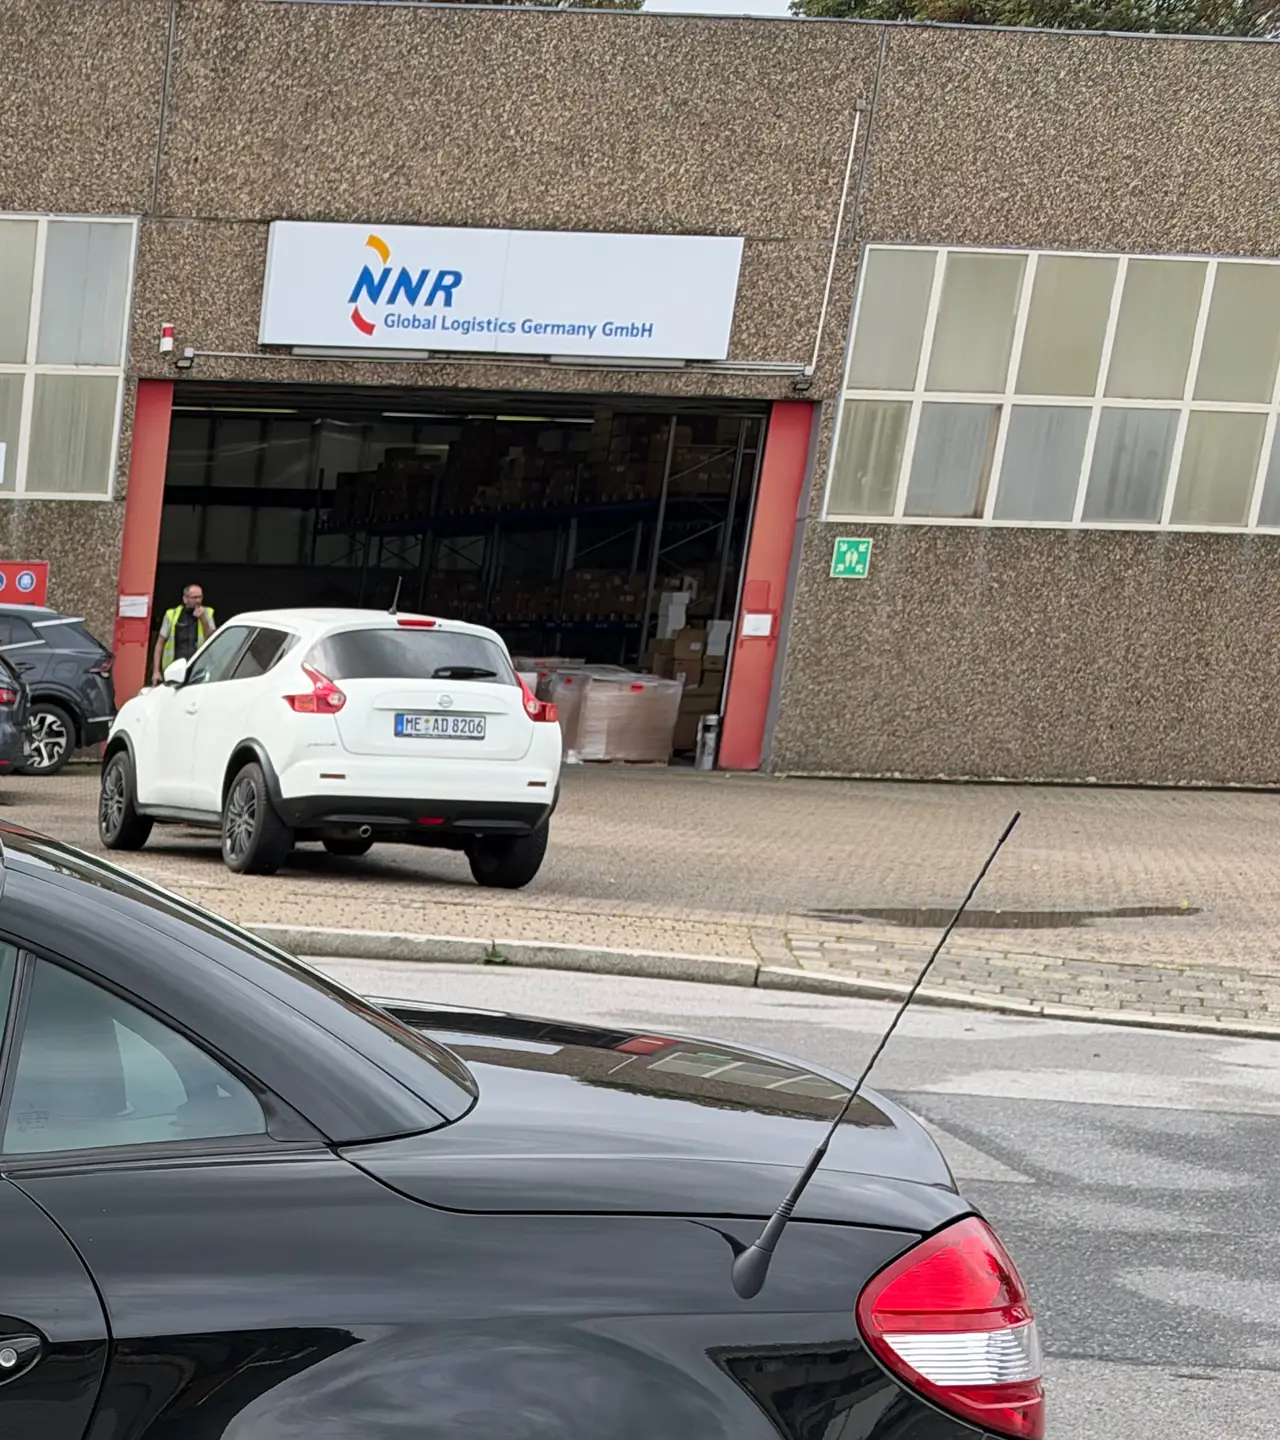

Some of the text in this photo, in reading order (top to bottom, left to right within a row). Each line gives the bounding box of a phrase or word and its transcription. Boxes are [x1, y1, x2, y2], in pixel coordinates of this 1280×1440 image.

[348, 264, 463, 307] NNR
[384, 313, 654, 339] Global Logistics Germany GmbH
[405, 717, 483, 734] ME AD 8206
